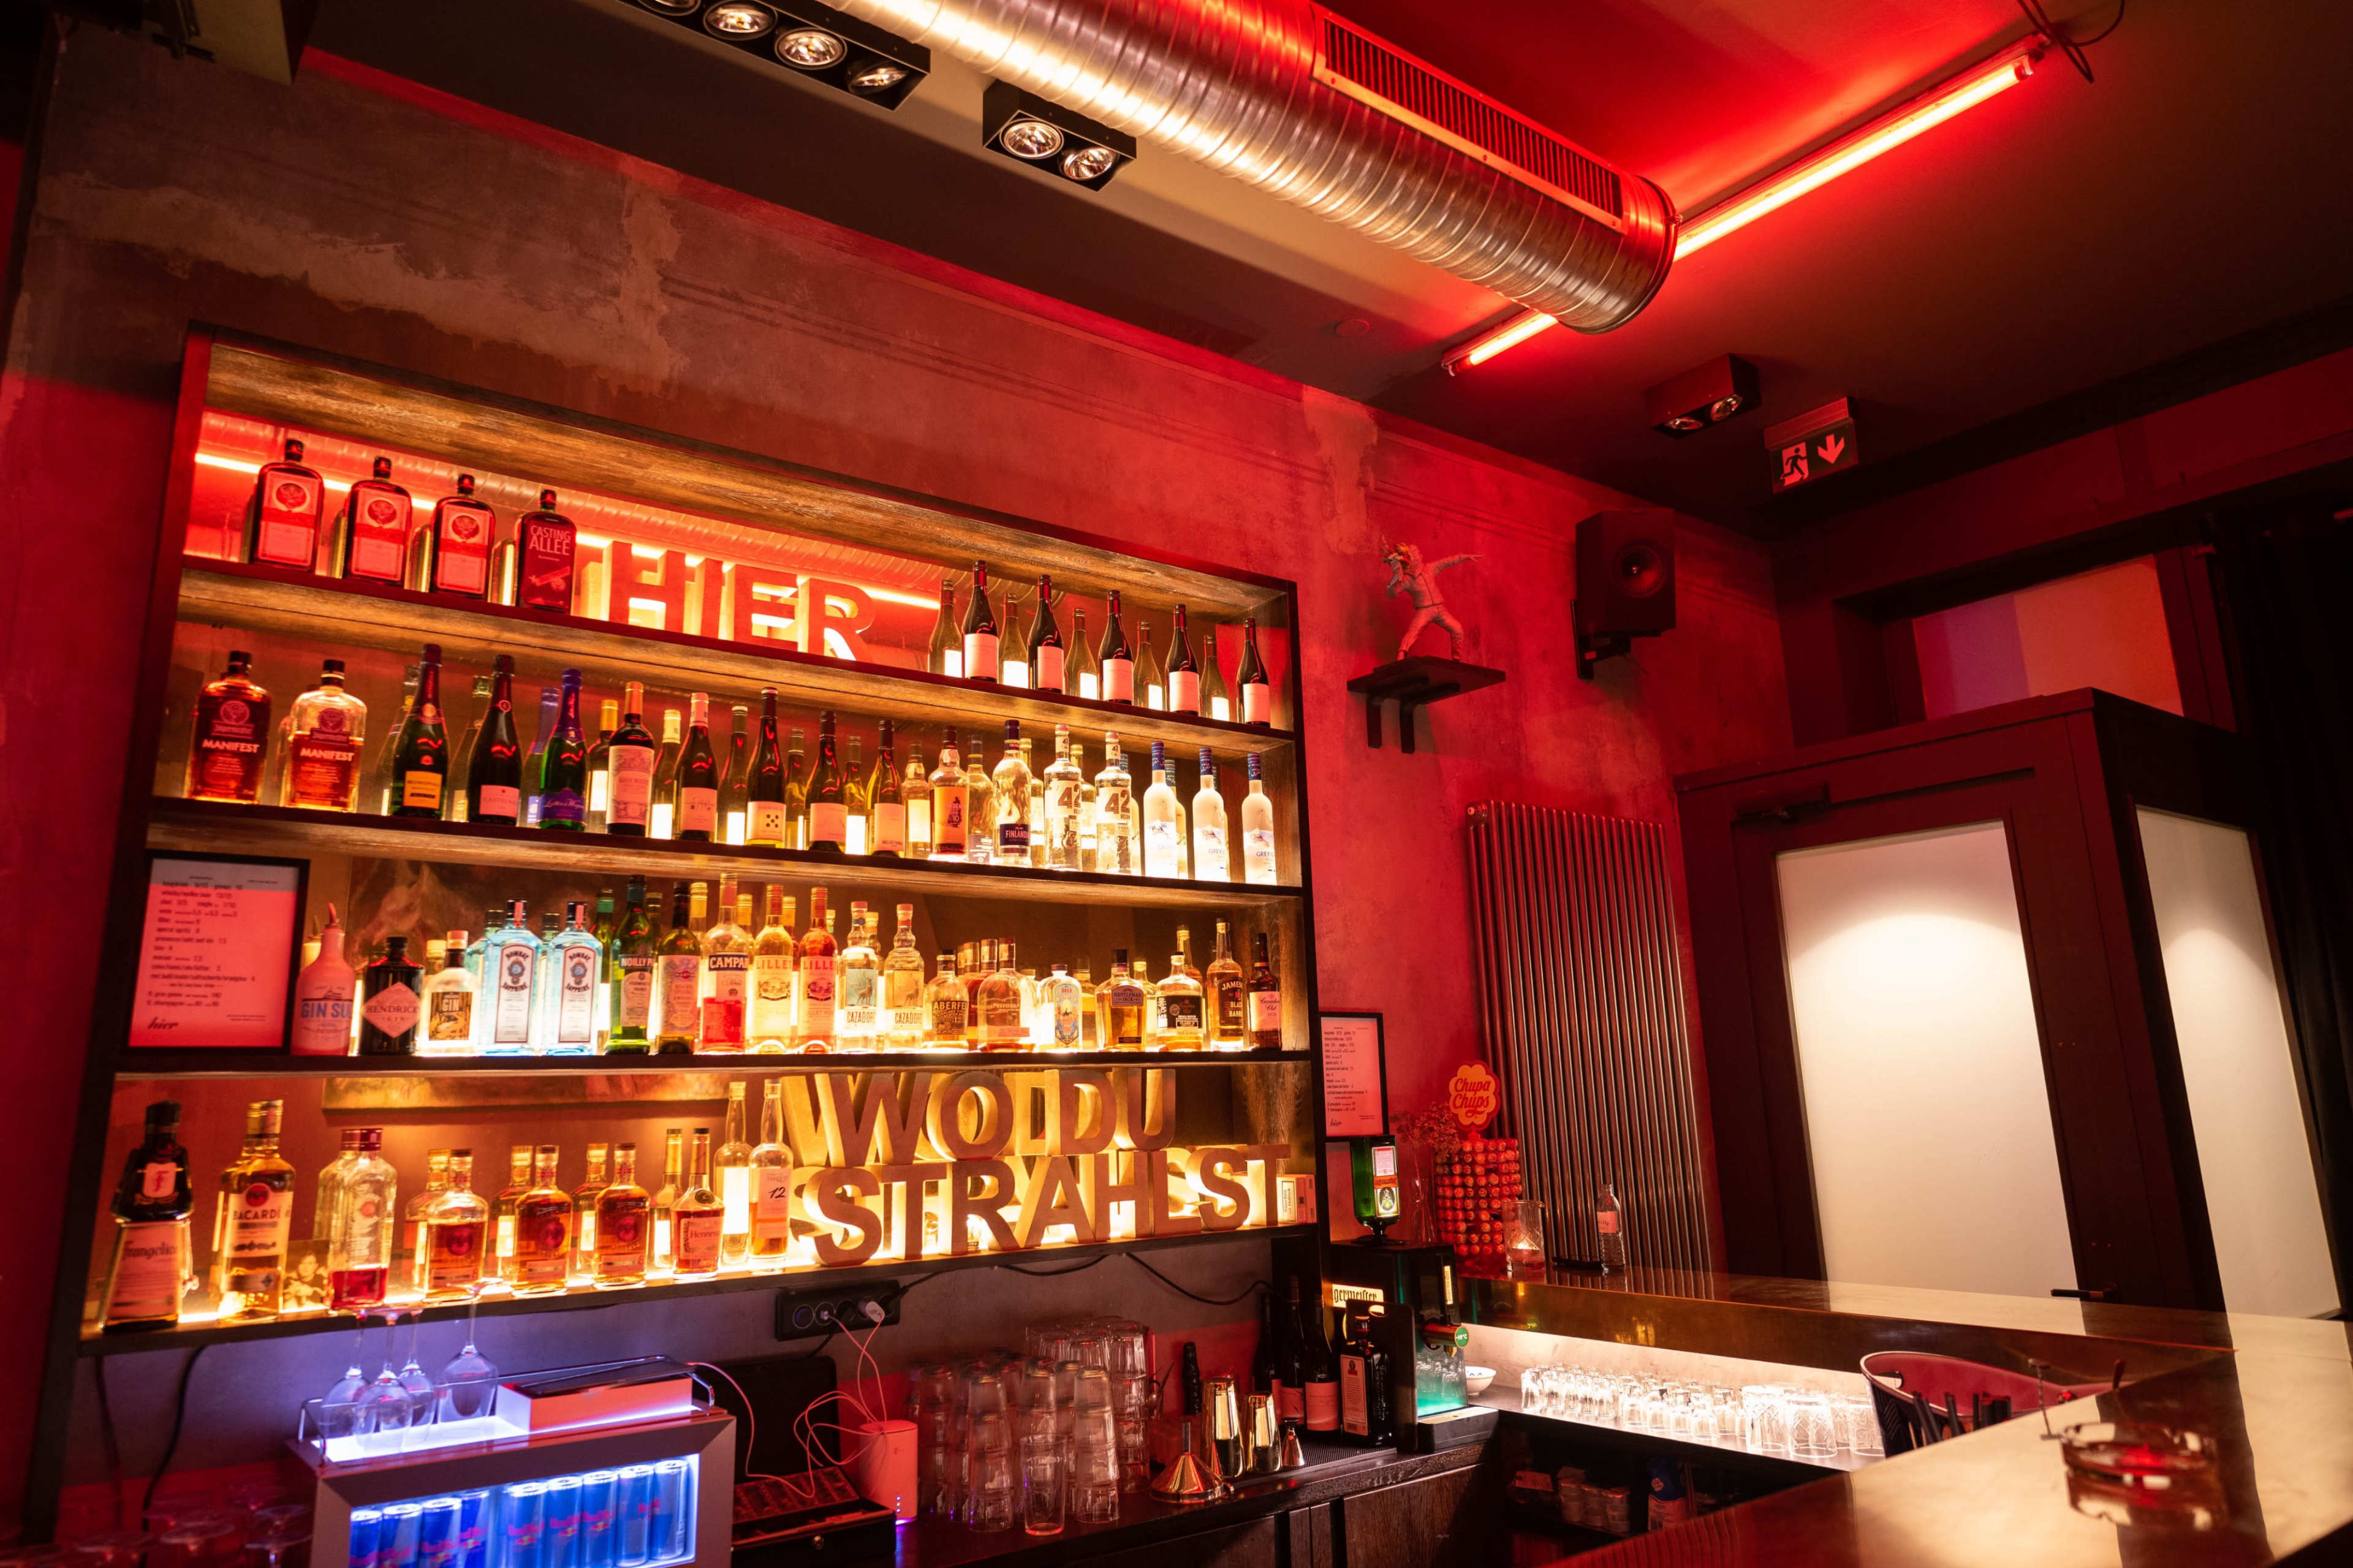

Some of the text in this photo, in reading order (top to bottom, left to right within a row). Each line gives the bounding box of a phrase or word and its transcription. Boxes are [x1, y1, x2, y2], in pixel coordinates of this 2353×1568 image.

[530, 525, 570, 542] CASTING
[529, 535, 570, 555] ALLEE
[608, 540, 875, 663] HIER
[202, 739, 259, 753] MANIFEST
[300, 748, 354, 762] MANIFEST
[1058, 783, 1082, 809] 42
[1105, 789, 1130, 814] 42
[505, 950, 529, 961] BOMBAY
[569, 952, 591, 962] BOMBAY
[621, 957, 647, 967] NOILLY
[301, 1002, 327, 1018] GIN
[442, 999, 459, 1012] GIN
[148, 1017, 178, 1029] hier
[1454, 1078, 1491, 1096] Chupa
[1453, 1093, 1490, 1118] Chups
[1329, 1118, 1342, 1127] hier
[768, 1187, 786, 1199] 12
[810, 1143, 1292, 1267] STRAHLST
